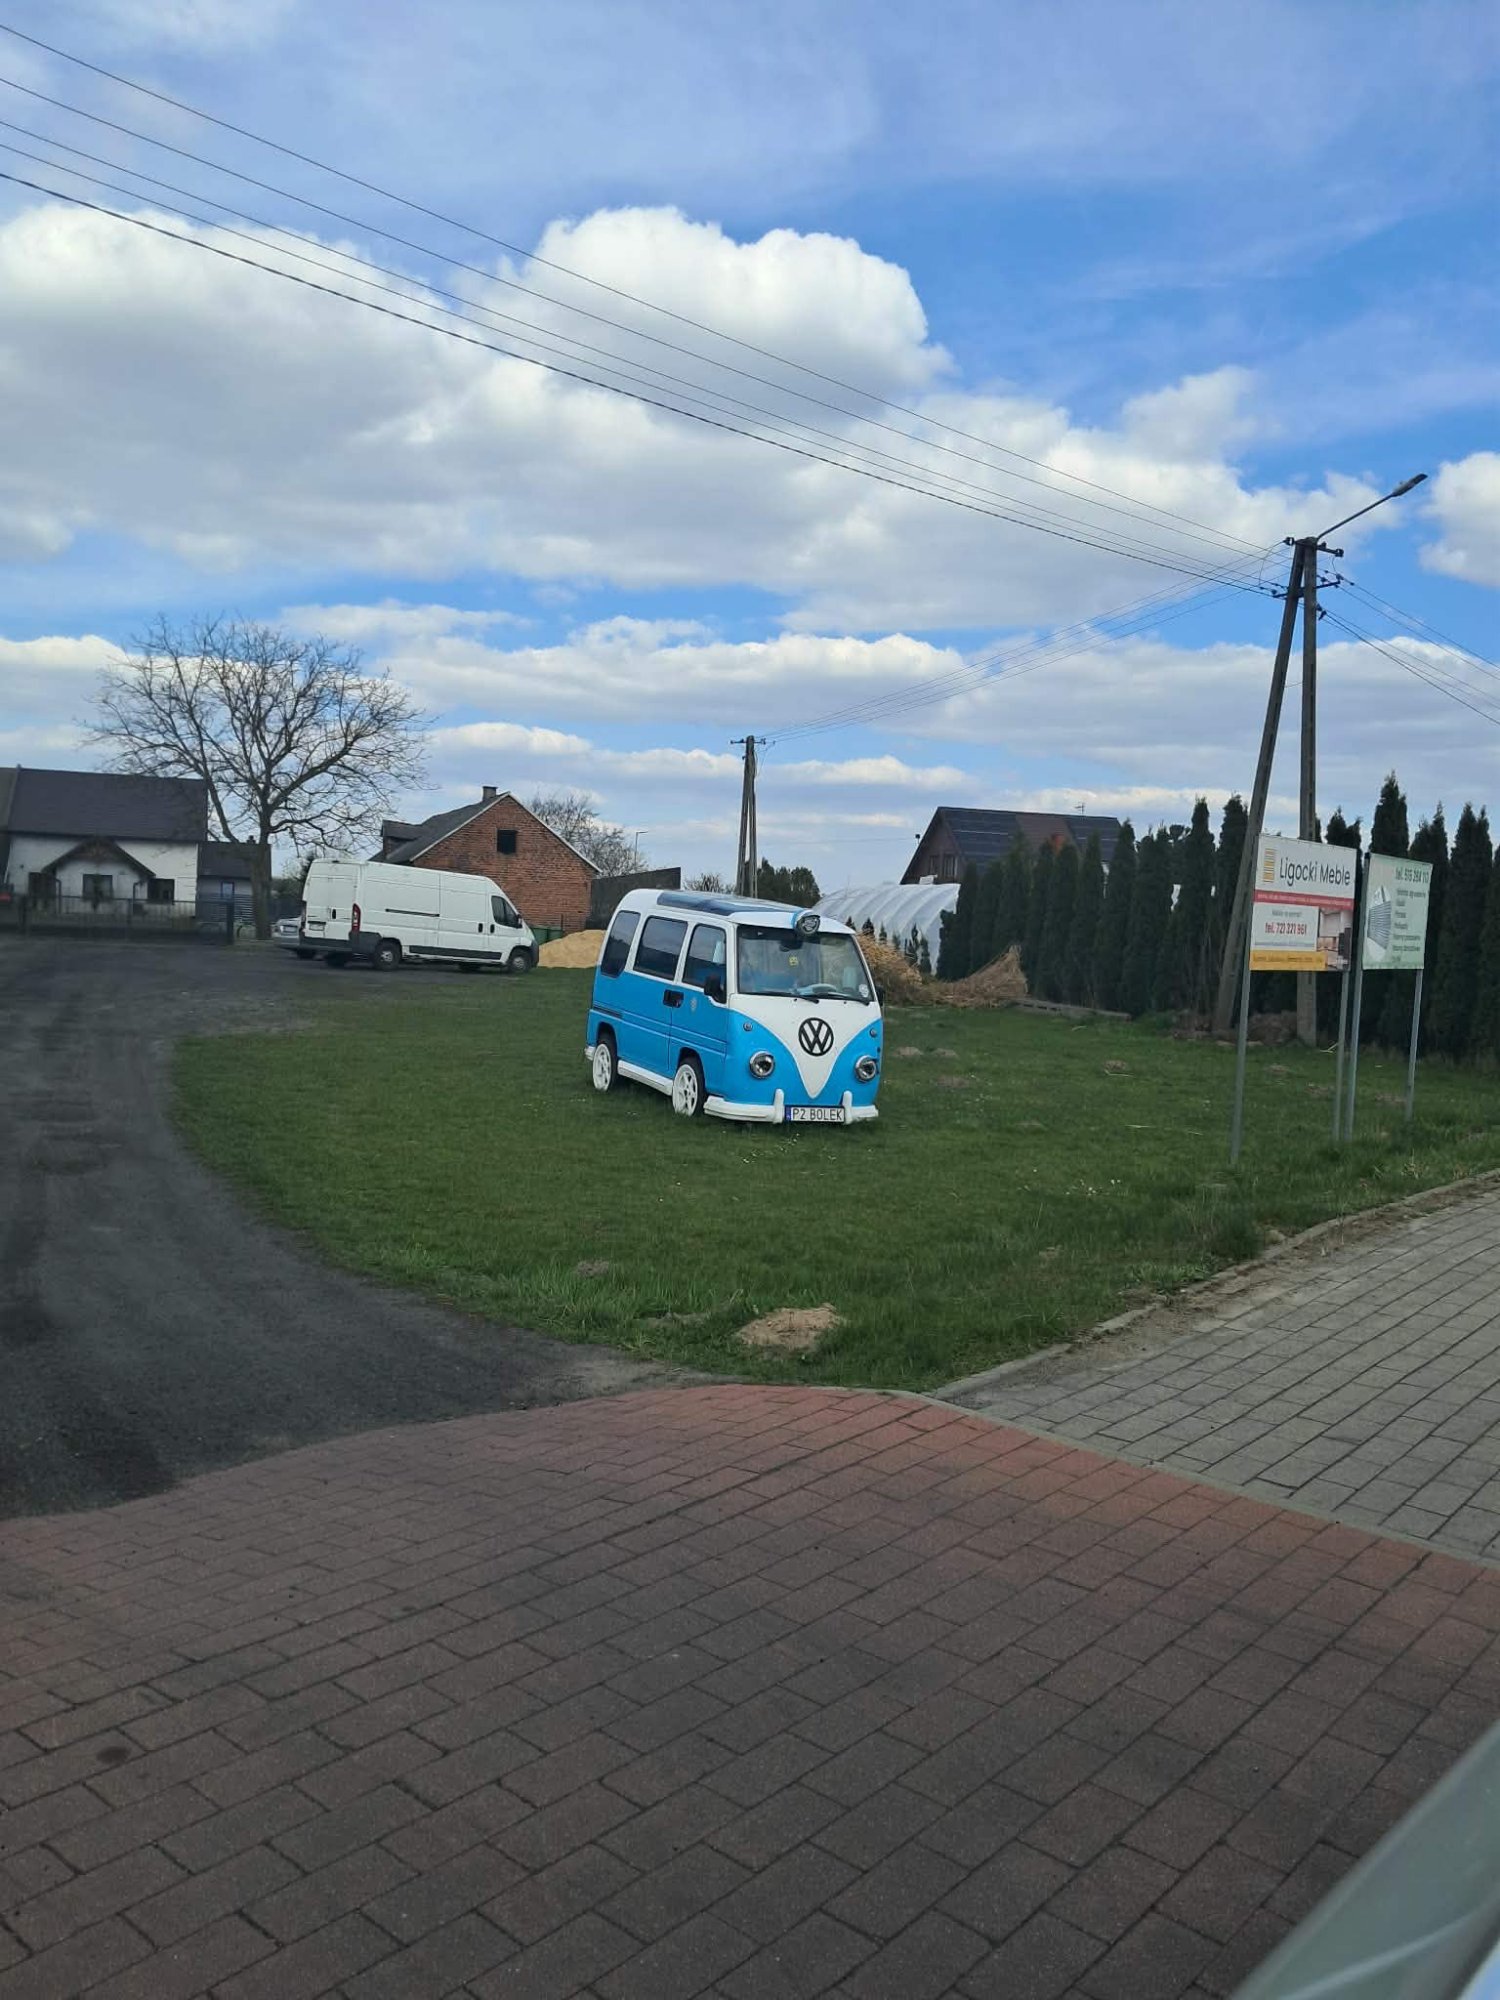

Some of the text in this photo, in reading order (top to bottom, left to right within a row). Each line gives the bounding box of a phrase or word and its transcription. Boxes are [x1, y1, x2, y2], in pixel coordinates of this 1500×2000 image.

[1280, 857, 1351, 887] Ligocki Meble
[799, 1017, 834, 1056] VW
[792, 1108, 842, 1121] P2 BOLEK
